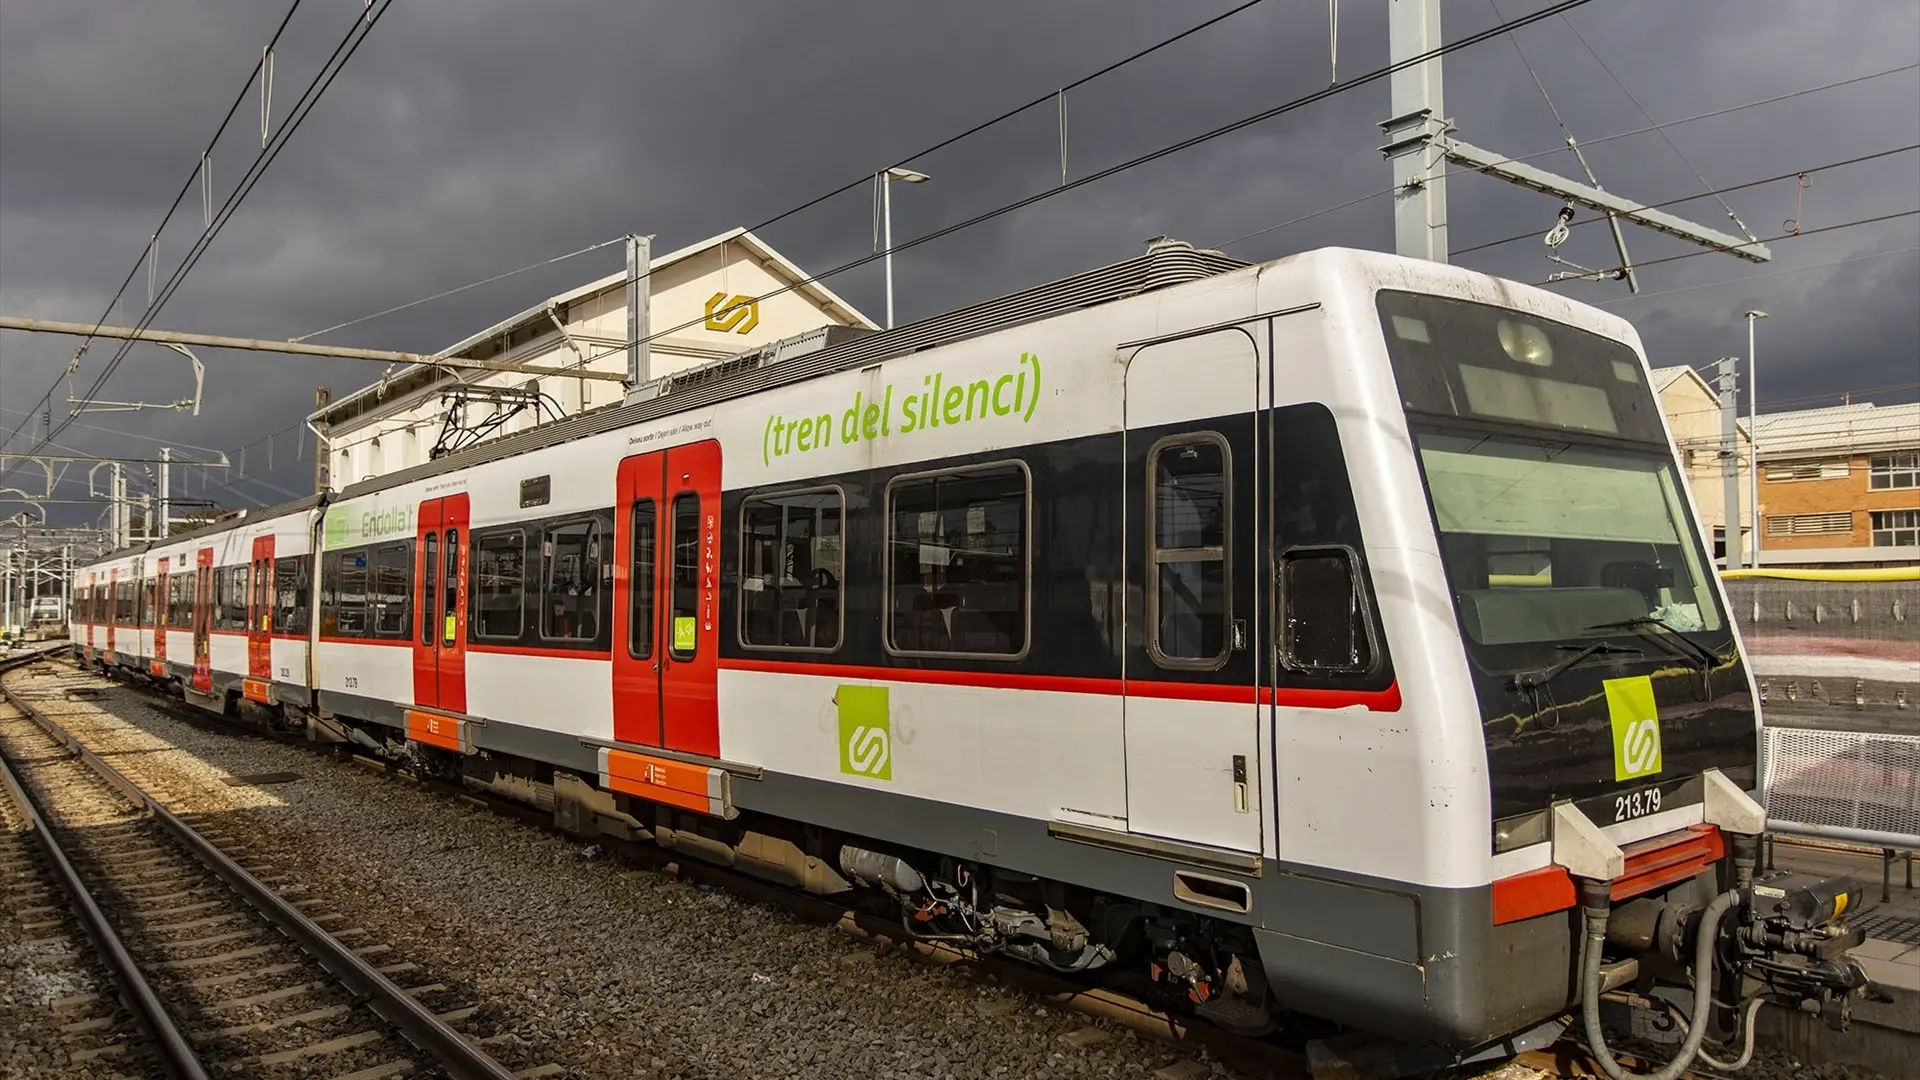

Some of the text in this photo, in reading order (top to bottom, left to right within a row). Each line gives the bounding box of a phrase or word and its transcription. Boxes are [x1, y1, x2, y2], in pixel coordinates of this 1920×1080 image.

[763, 352, 1041, 467] (tren del silenci)
[1615, 788, 1661, 822] 213.79
